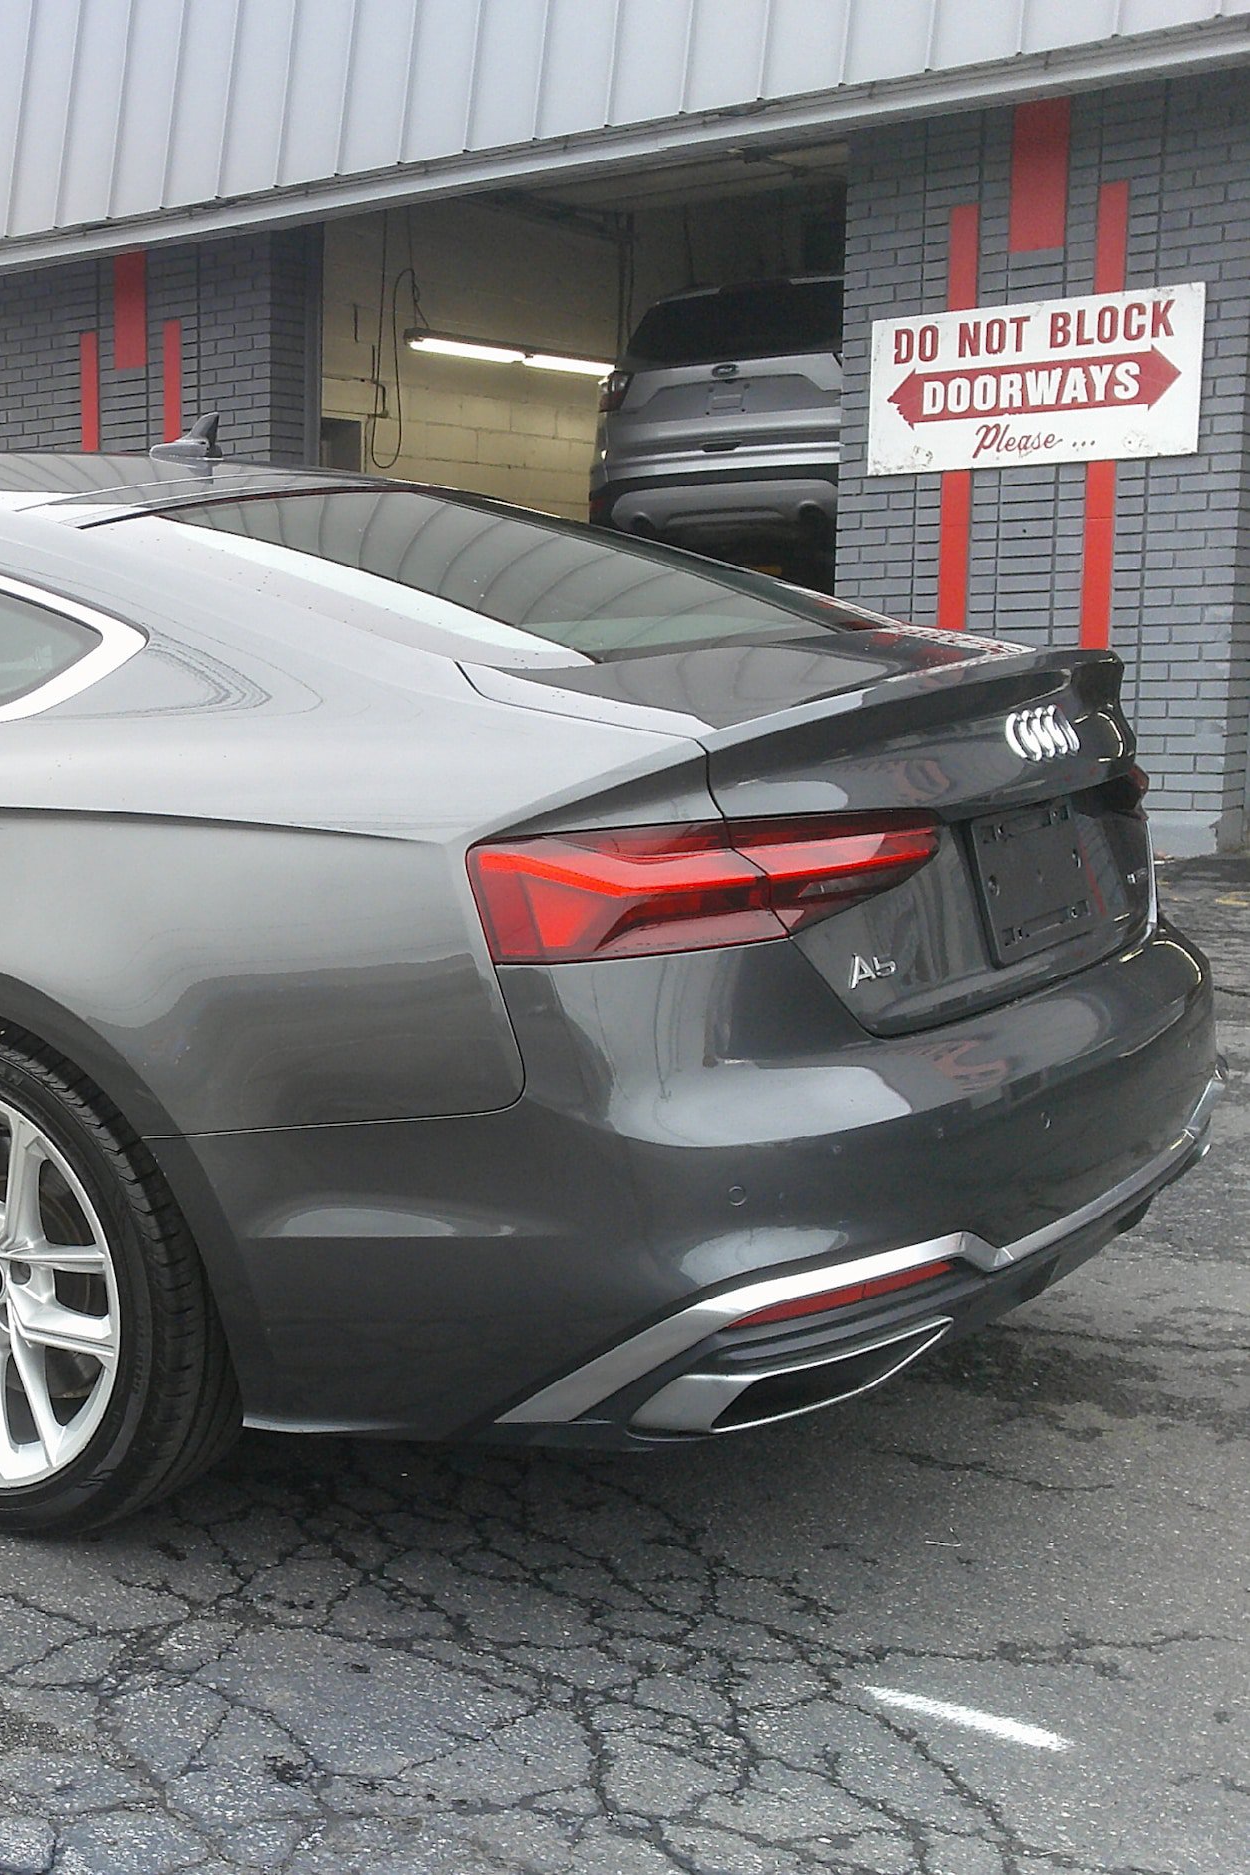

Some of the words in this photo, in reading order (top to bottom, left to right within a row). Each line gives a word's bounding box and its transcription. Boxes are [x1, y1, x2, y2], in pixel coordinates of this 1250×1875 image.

[893, 324, 940, 365] DO
[958, 315, 1031, 358] NOT
[1049, 299, 1176, 349] BLOCK
[921, 361, 1141, 416] DOORWAYS
[971, 423, 1064, 459] Please
[848, 953, 897, 990] A5
